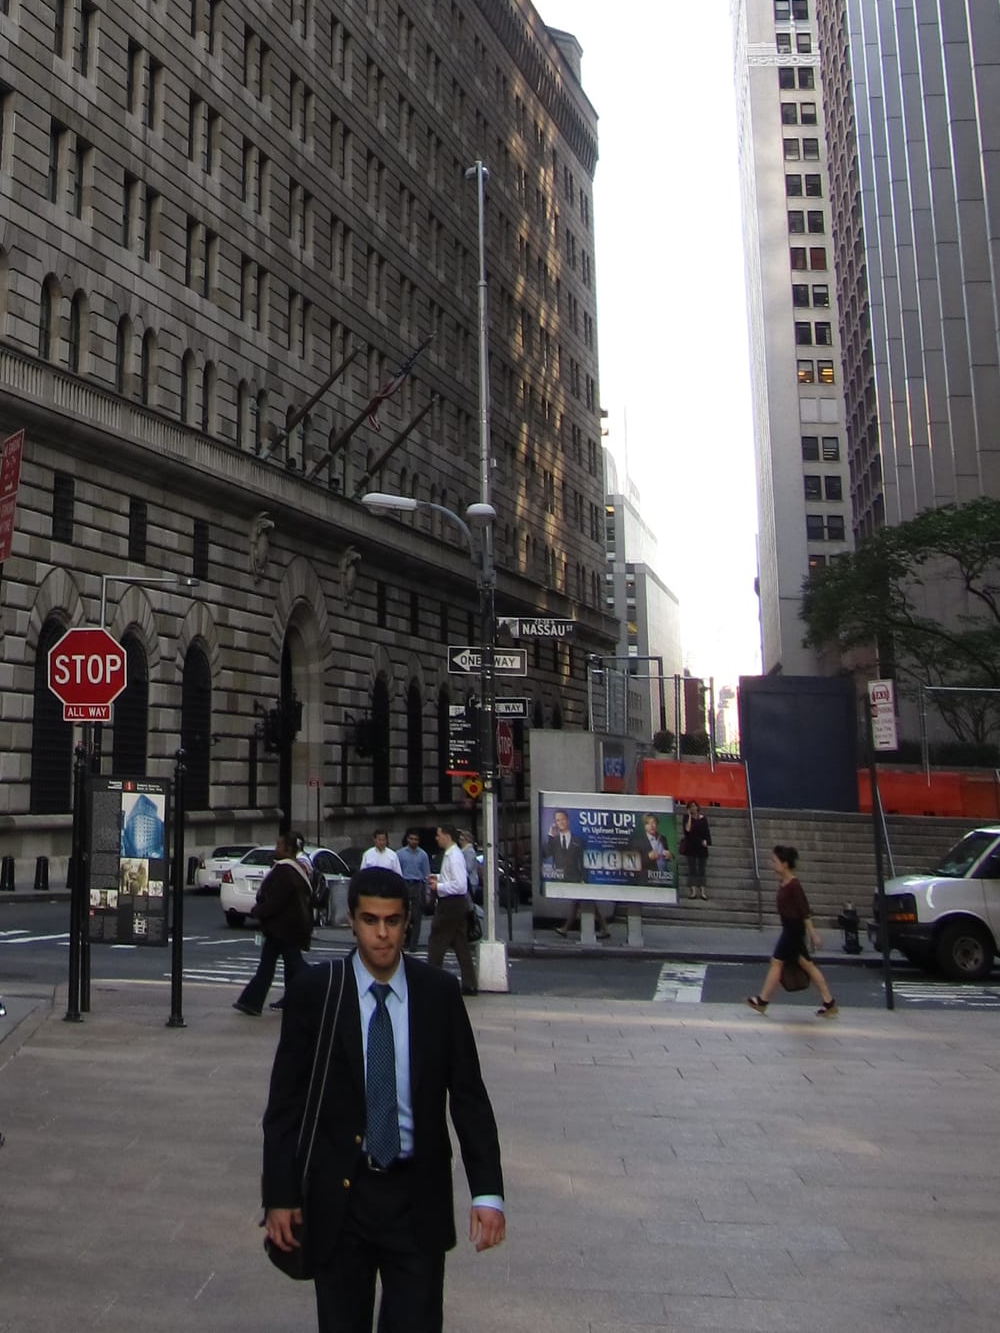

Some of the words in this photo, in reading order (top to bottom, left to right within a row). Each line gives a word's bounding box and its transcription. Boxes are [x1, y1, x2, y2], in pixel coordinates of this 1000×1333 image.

[522, 623, 566, 637] NASSAU
[460, 654, 482, 666] ONE
[54, 653, 122, 685] STOP
[67, 707, 85, 717] ALL
[88, 707, 107, 716] WAY
[504, 704, 521, 712] WAY
[579, 811, 609, 826] SUIT
[612, 812, 637, 828] UP!
